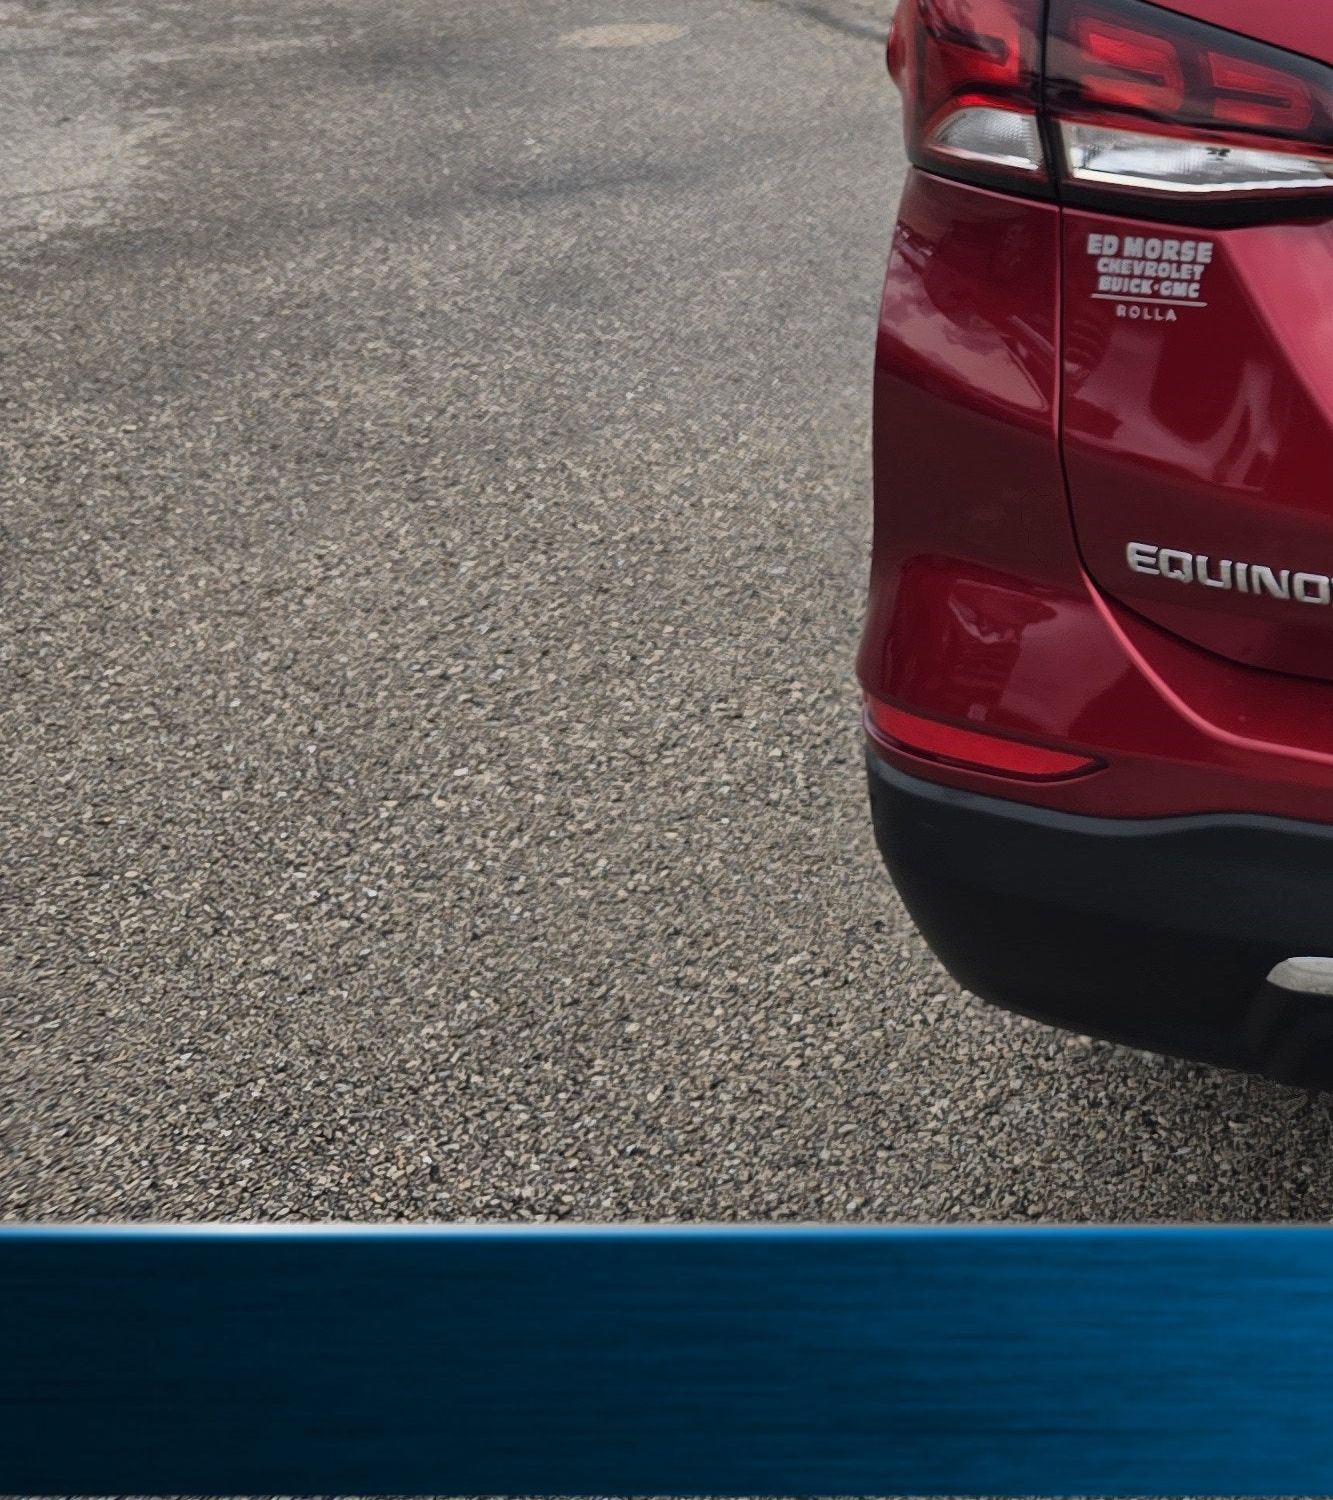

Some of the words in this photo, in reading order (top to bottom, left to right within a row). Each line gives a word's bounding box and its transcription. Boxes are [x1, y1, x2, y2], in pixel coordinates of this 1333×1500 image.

[1086, 232, 1120, 256] ED
[1122, 235, 1214, 264] MORSE
[1097, 256, 1206, 281] CHEVROLET
[1115, 303, 1178, 322] ROLLA
